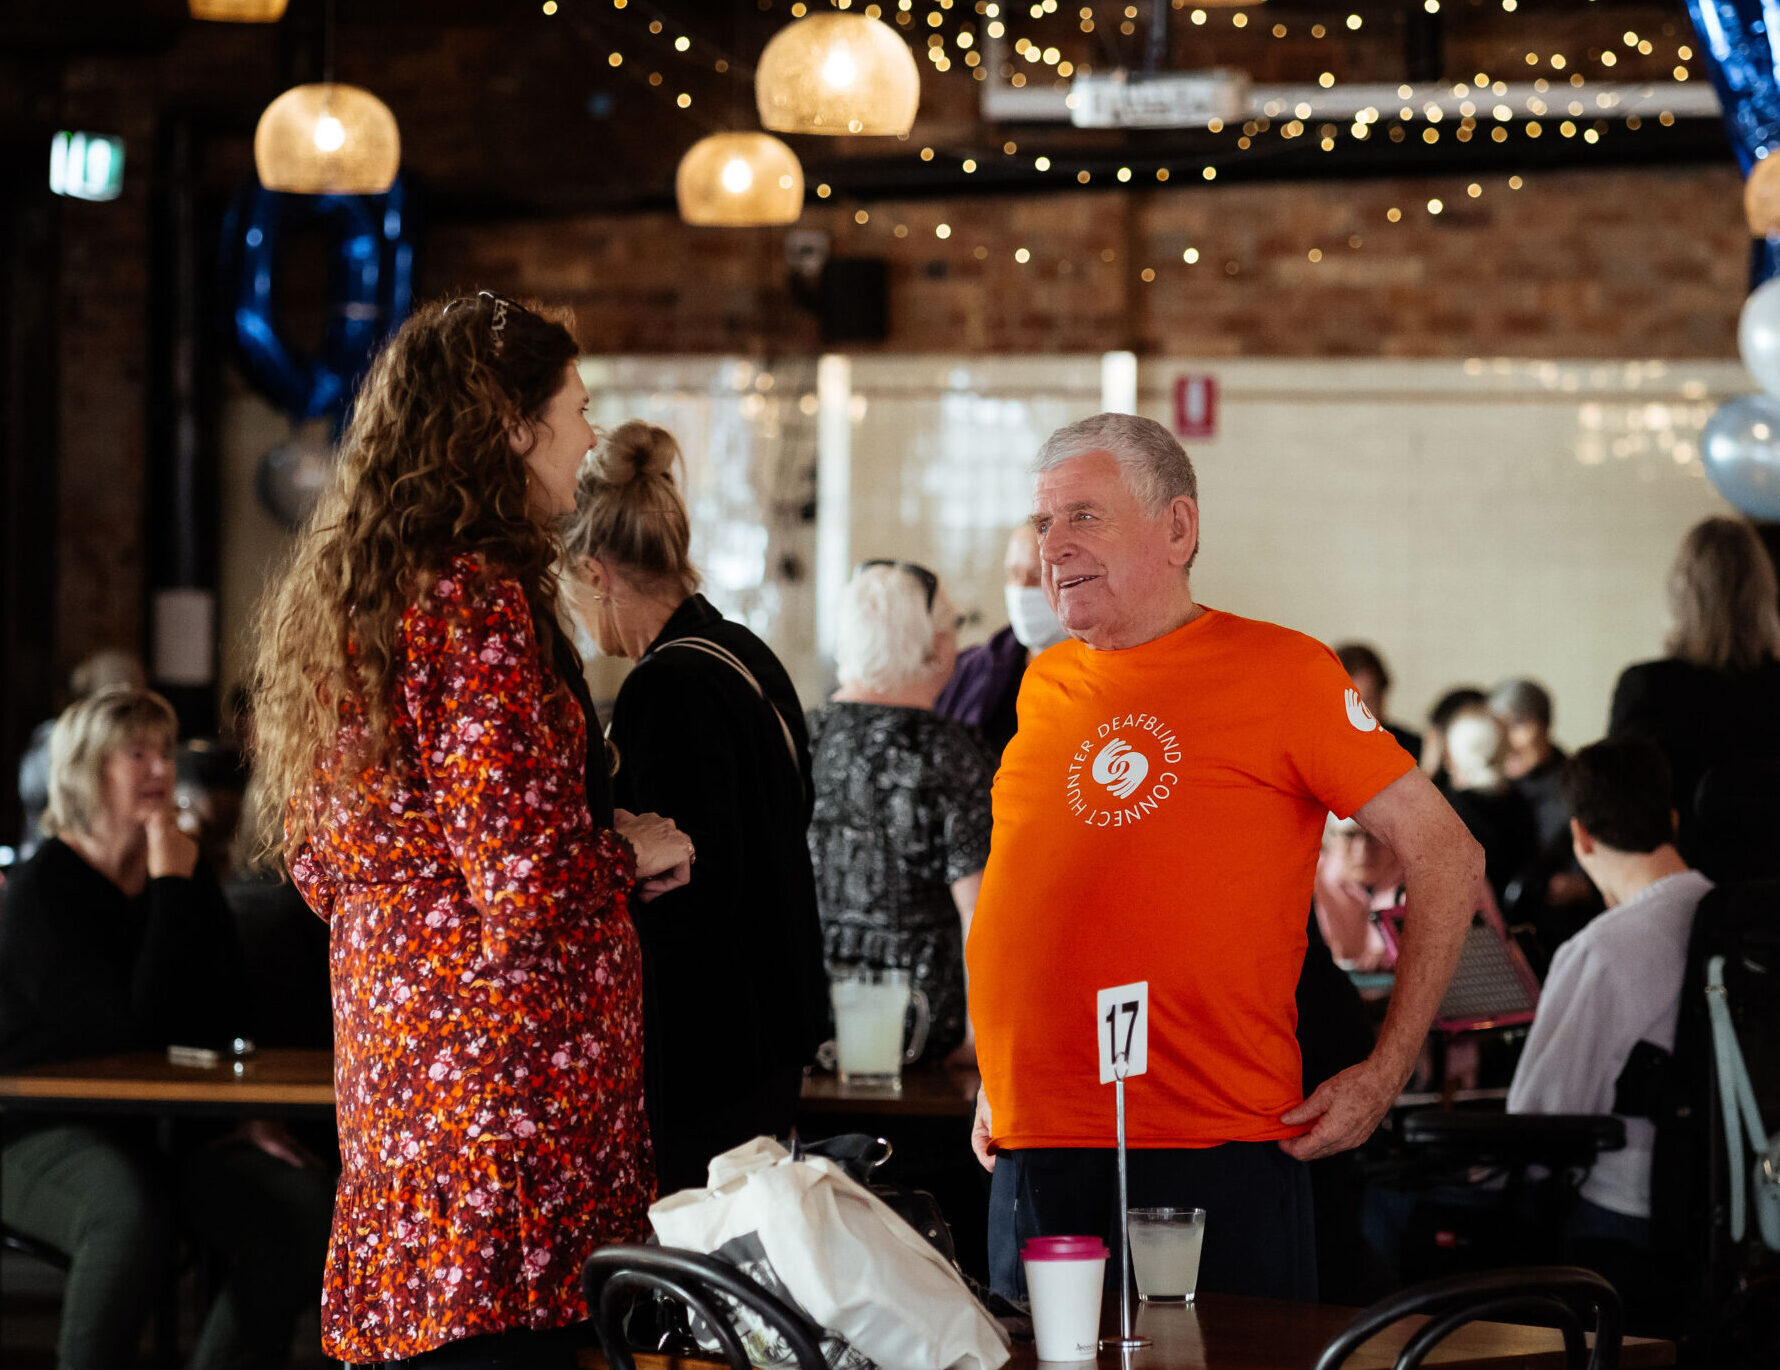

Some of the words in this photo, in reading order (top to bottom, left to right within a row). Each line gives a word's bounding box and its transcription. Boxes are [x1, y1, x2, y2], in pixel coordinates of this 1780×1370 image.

[1097, 713, 1182, 764] DEAFBLIND
[1066, 739, 1095, 817] HUNTER
[1084, 772, 1178, 827] CONNECT
[1106, 1000, 1139, 1065] 17
